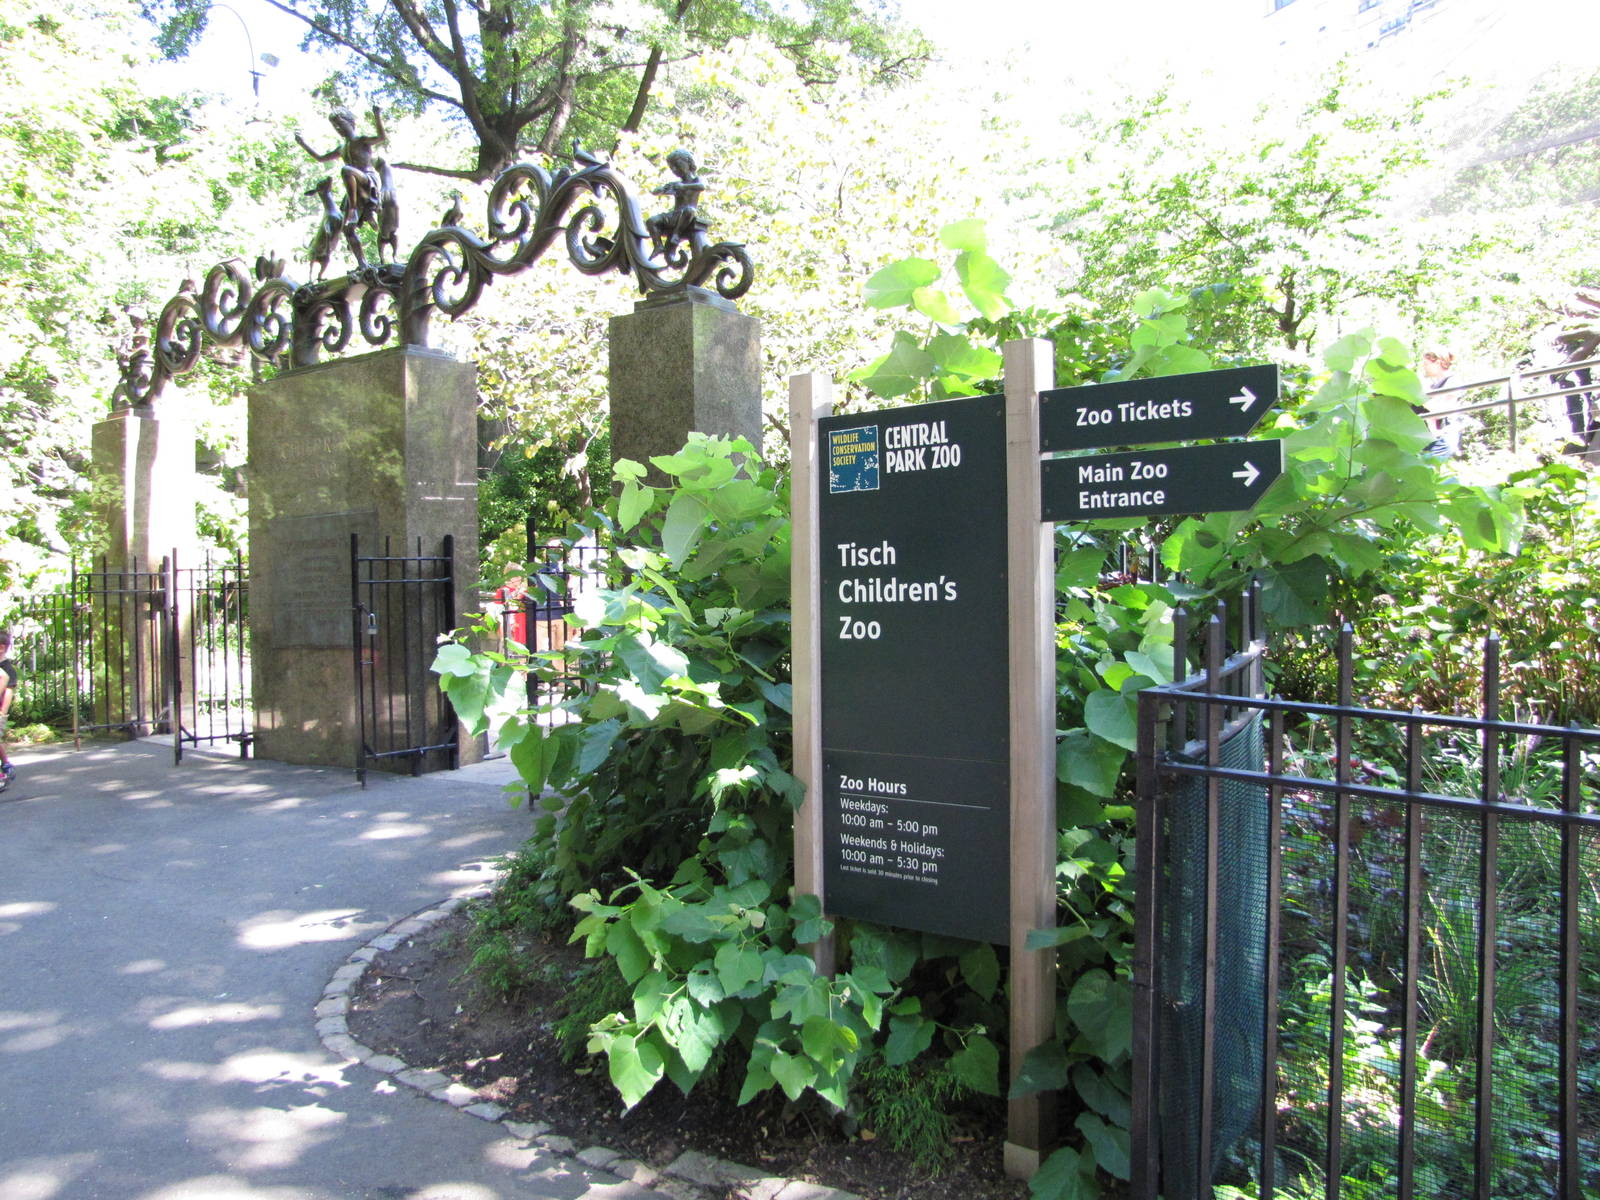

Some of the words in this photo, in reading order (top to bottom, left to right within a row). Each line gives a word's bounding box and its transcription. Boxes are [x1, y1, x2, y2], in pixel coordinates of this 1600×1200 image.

[1076, 408, 1113, 427] Zoo
[1118, 399, 1192, 422] Tickets
[832, 432, 860, 445] WILDLIFE
[885, 420, 949, 450] CENTRAL
[832, 441, 877, 456] CONSERVATION
[832, 454, 857, 467] SOCIETY
[886, 448, 926, 474] PARK
[932, 444, 961, 469] ZOO
[1078, 464, 1123, 484] Main
[1130, 461, 1168, 480] Zoo
[1079, 490, 1165, 509] Entrance
[837, 540, 897, 567] Tisch
[838, 575, 957, 604] Children's
[839, 616, 881, 640] Zoo
[840, 775, 864, 790] Zoo
[868, 777, 907, 795] Hours
[840, 797, 889, 816] Weekdays:
[841, 813, 867, 827] 10:00
[869, 817, 884, 829] am
[897, 819, 919, 833] 5:00
[922, 823, 938, 837] pm
[840, 833, 887, 850] Weekends
[890, 839, 898, 851] &
[900, 840, 945, 859] Holidays:
[841, 848, 867, 863] 10:00
[869, 853, 884, 865] am
[897, 856, 919, 870] 5:30
[922, 860, 938, 874] pm
